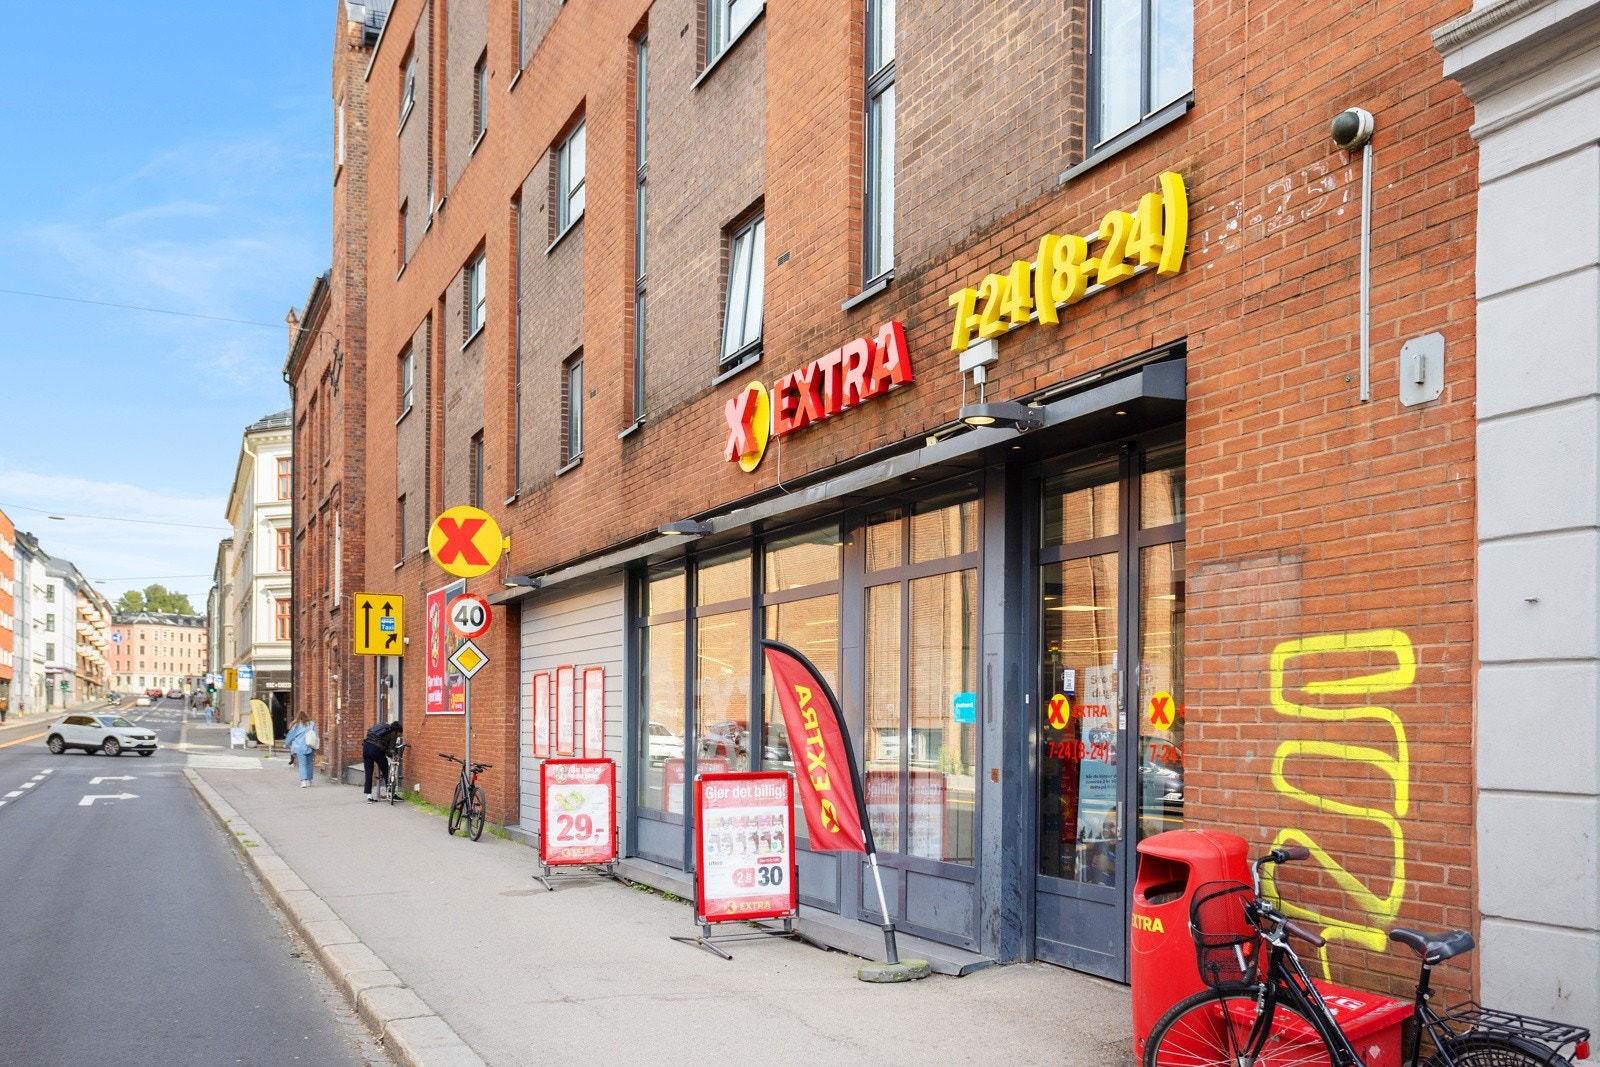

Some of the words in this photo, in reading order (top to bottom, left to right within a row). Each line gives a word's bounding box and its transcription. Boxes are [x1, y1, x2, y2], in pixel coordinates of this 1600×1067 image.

[774, 320, 914, 436] EXTRA
[437, 517, 490, 566] X
[454, 605, 485, 627] 40
[1049, 700, 1065, 724] X
[1072, 705, 1108, 718] EXTRA
[1151, 697, 1170, 725] X
[705, 785, 729, 802] Gjør
[732, 785, 752, 799] det
[754, 783, 786, 800] billig!
[736, 872, 744, 884] 2
[758, 865, 784, 887] 30
[739, 900, 771, 911] EXTRA
